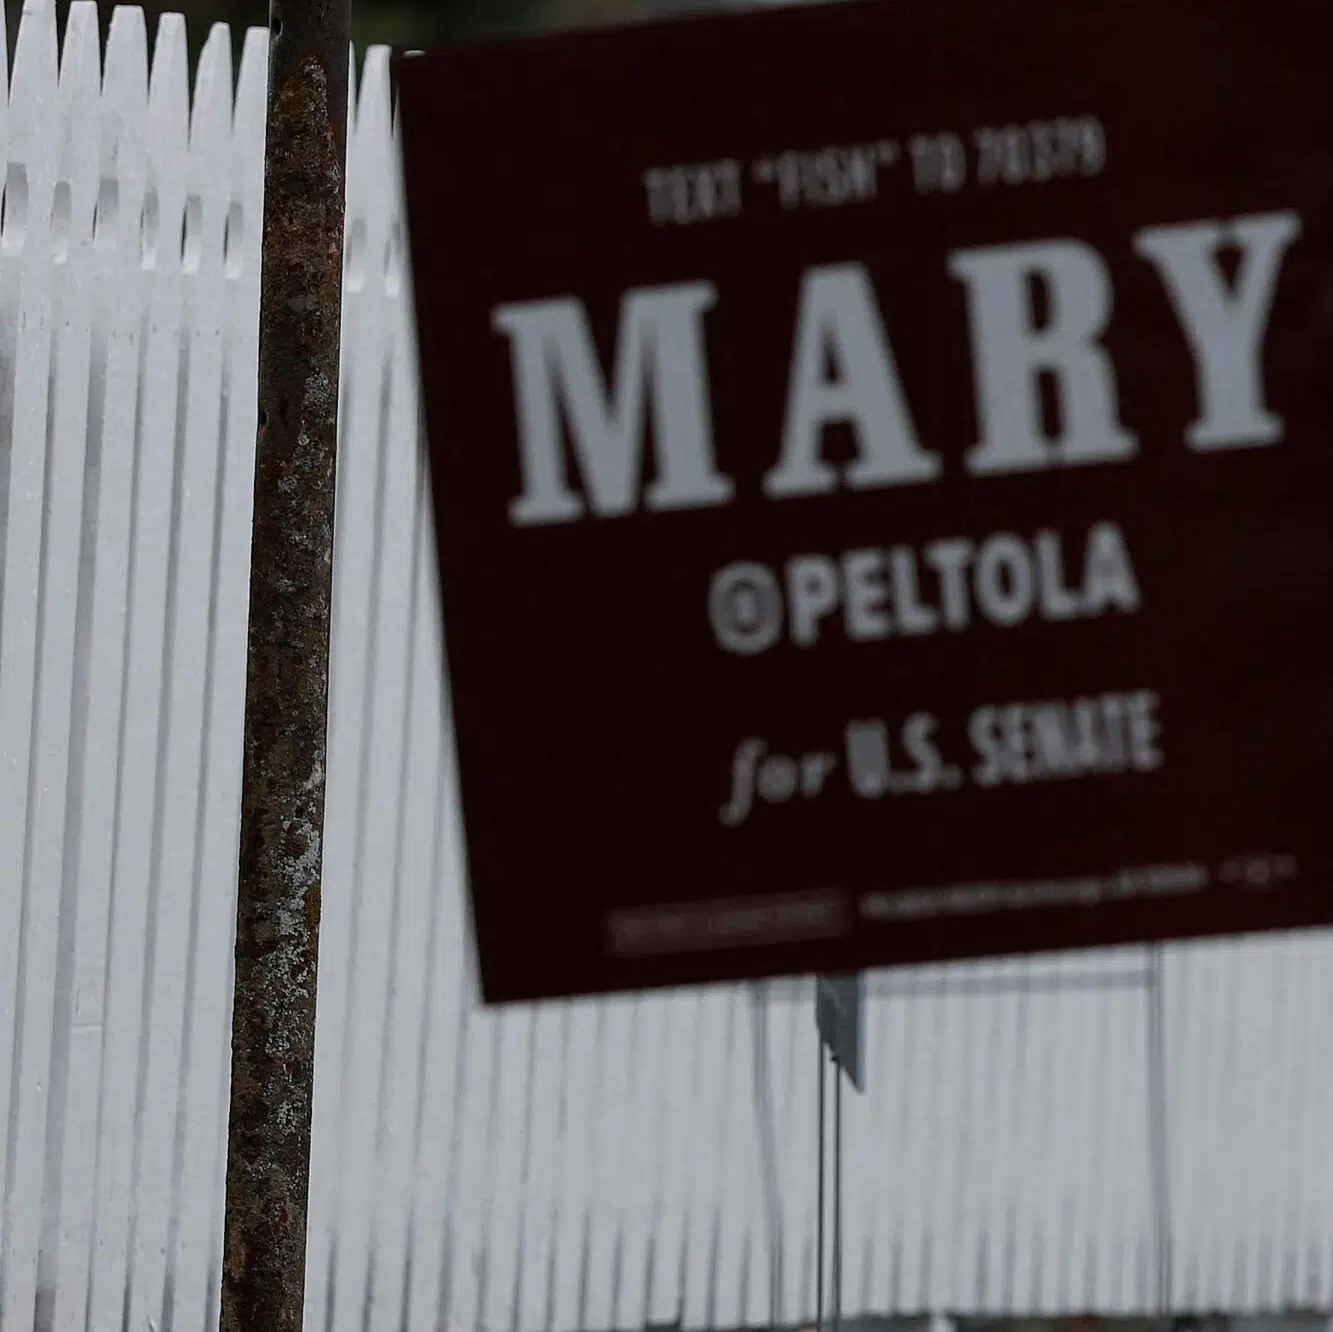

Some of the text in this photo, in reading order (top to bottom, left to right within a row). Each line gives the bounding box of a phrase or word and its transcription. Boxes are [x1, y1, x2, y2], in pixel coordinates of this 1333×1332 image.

[642, 157, 743, 227] TEXT
[907, 129, 968, 196] TO
[490, 207, 1303, 528] MARY
[706, 519, 1142, 657] @PELTOLA
[717, 687, 1165, 828] for U.S. SENATE
